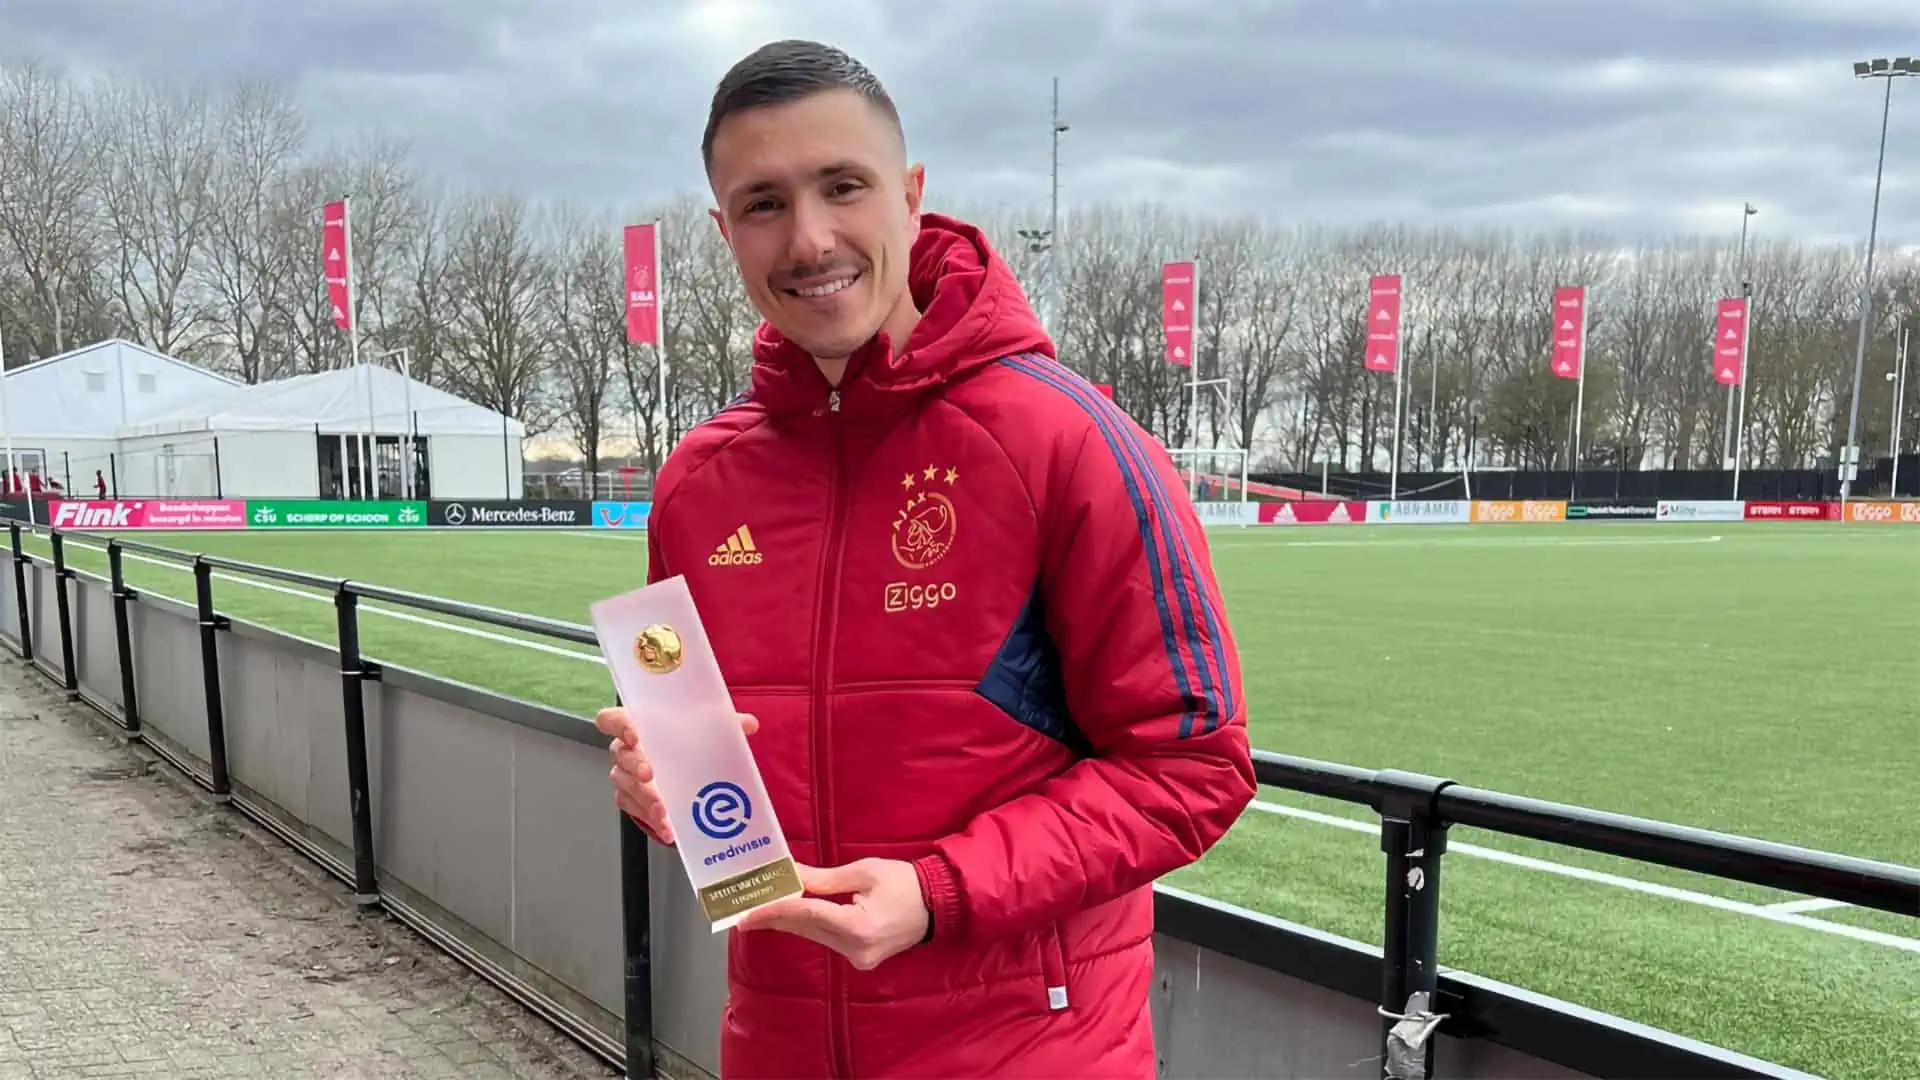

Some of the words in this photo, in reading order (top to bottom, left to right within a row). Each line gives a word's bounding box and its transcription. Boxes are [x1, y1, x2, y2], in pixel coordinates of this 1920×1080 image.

[53, 502, 132, 526] Flink
[254, 513, 277, 523] CSU
[286, 513, 328, 523] SCHERP
[329, 513, 344, 523] OP
[345, 513, 389, 523] SCHOON
[398, 513, 419, 523] CSU
[472, 507, 576, 522] Mercedes-Benz
[892, 491, 927, 532] AJAX
[708, 552, 763, 566] adidas
[885, 582, 957, 612] Ziggo
[704, 836, 771, 866] eredivisie
